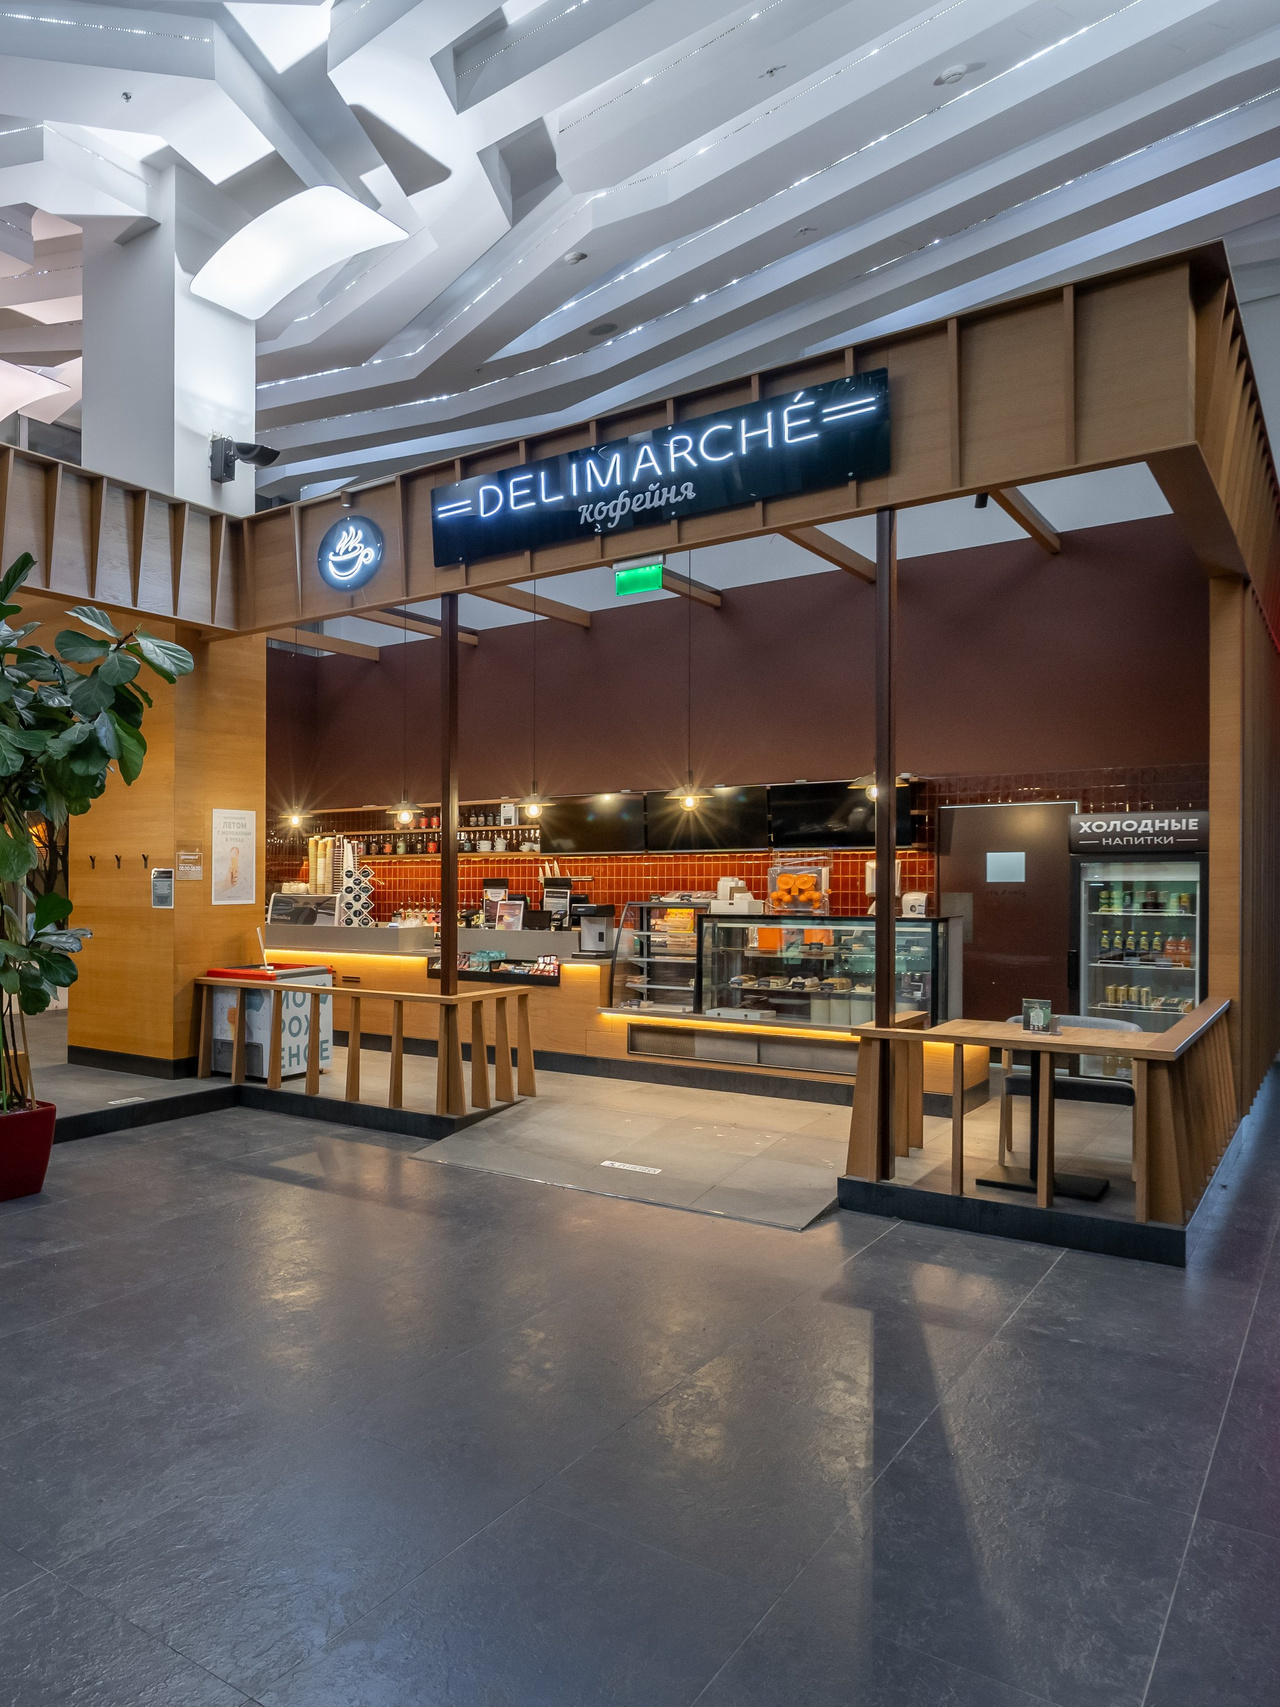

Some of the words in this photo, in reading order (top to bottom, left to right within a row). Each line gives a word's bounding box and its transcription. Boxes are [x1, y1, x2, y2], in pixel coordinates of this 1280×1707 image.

[477, 390, 820, 519] DELIMARCHÉ
[577, 481, 697, 529] кофейня
[222, 821, 248, 829] ЛЕТОМ
[1078, 818, 1199, 834] ХОЛОДНЫЕ
[1101, 836, 1174, 846] НАПИТКИ
